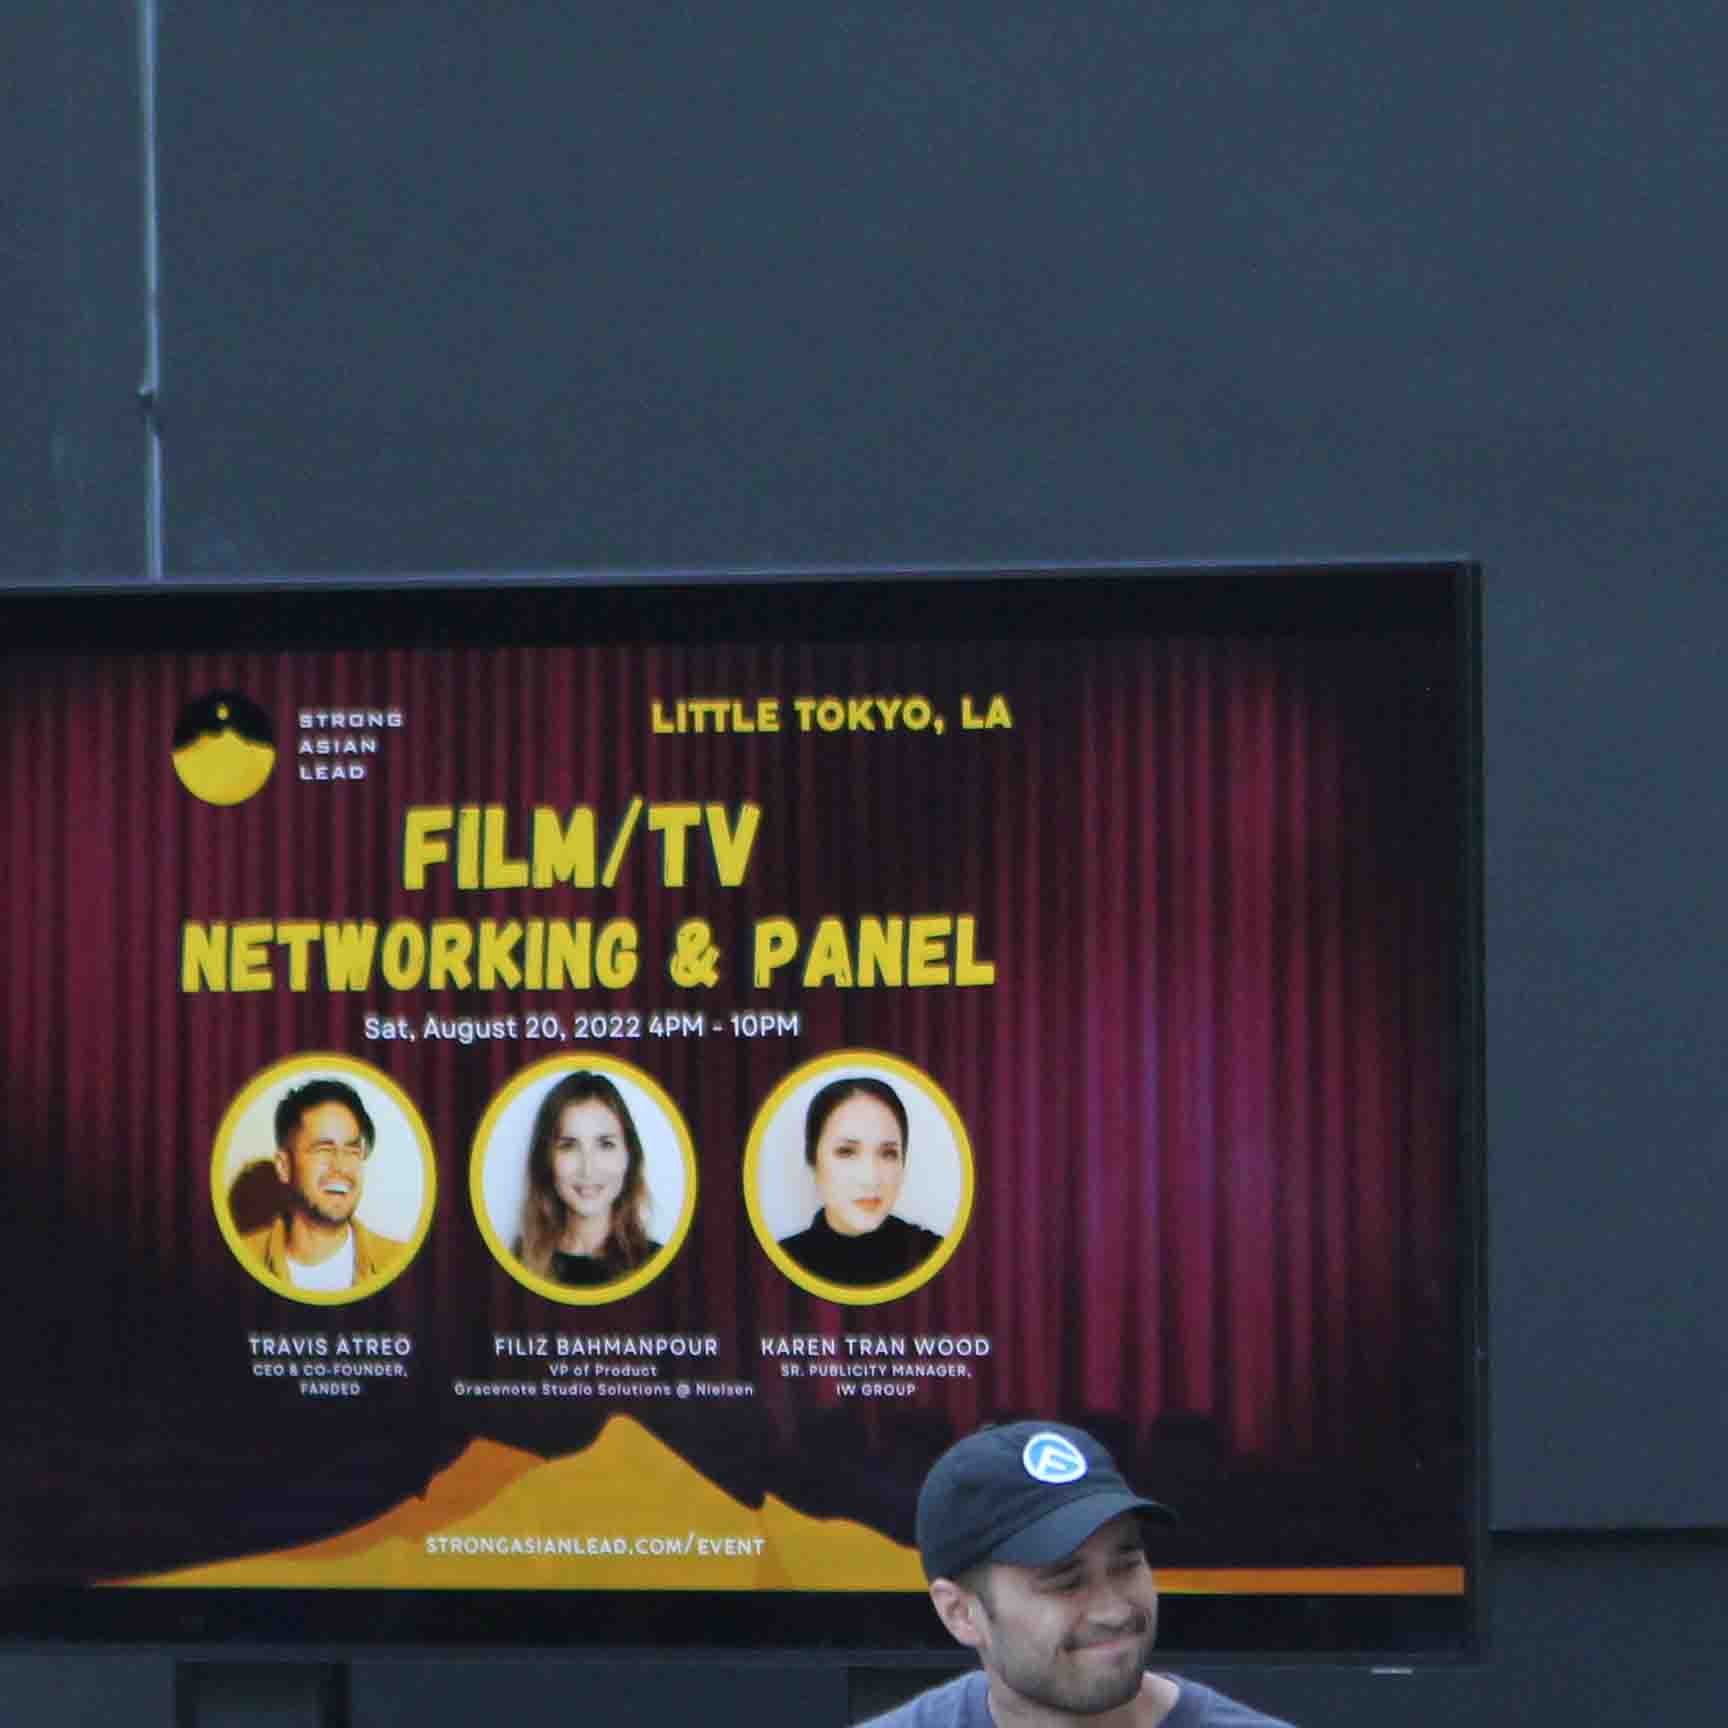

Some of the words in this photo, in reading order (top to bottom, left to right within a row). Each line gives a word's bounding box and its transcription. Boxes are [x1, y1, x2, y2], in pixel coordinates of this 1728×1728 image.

[299, 711, 404, 729] STRONG
[651, 698, 780, 734] LITTLE
[794, 696, 945, 736] TOKYO,
[960, 695, 1013, 730] LA
[299, 738, 377, 755] ASIAN
[299, 763, 366, 781] LEAD
[403, 794, 761, 891] FILM/TV
[180, 917, 640, 993] NETWORKING
[669, 915, 720, 989] &
[753, 914, 996, 989] PANEL
[364, 1016, 416, 1042] Sat,
[423, 1016, 518, 1044] August
[525, 1016, 567, 1042] 20,
[575, 1016, 641, 1040] 2022
[648, 1015, 703, 1039] 4PM
[731, 1014, 799, 1038] 10PM
[249, 1338, 329, 1356] TRAVIS
[336, 1338, 411, 1356] ATREO
[495, 1338, 549, 1356] FILIZ
[556, 1338, 719, 1356] BAHMANPOUR
[761, 1338, 835, 1356] KAREN
[845, 1338, 905, 1356] TRAN
[913, 1338, 990, 1356] WOOD
[253, 1364, 284, 1377] CEO
[549, 1364, 571, 1377] VP
[574, 1364, 591, 1377] of
[595, 1364, 657, 1377] Product
[809, 1364, 887, 1377] PUBLICITY
[454, 1383, 537, 1396] Gracenote
[542, 1383, 592, 1396] Studio
[599, 1383, 671, 1396] Solutions
[677, 1383, 690, 1397] @
[696, 1383, 754, 1396] Nielsen
[861, 1384, 916, 1397] GROUP
[425, 1531, 766, 1556] STRONGASIANLEAD.COM/EVENT
